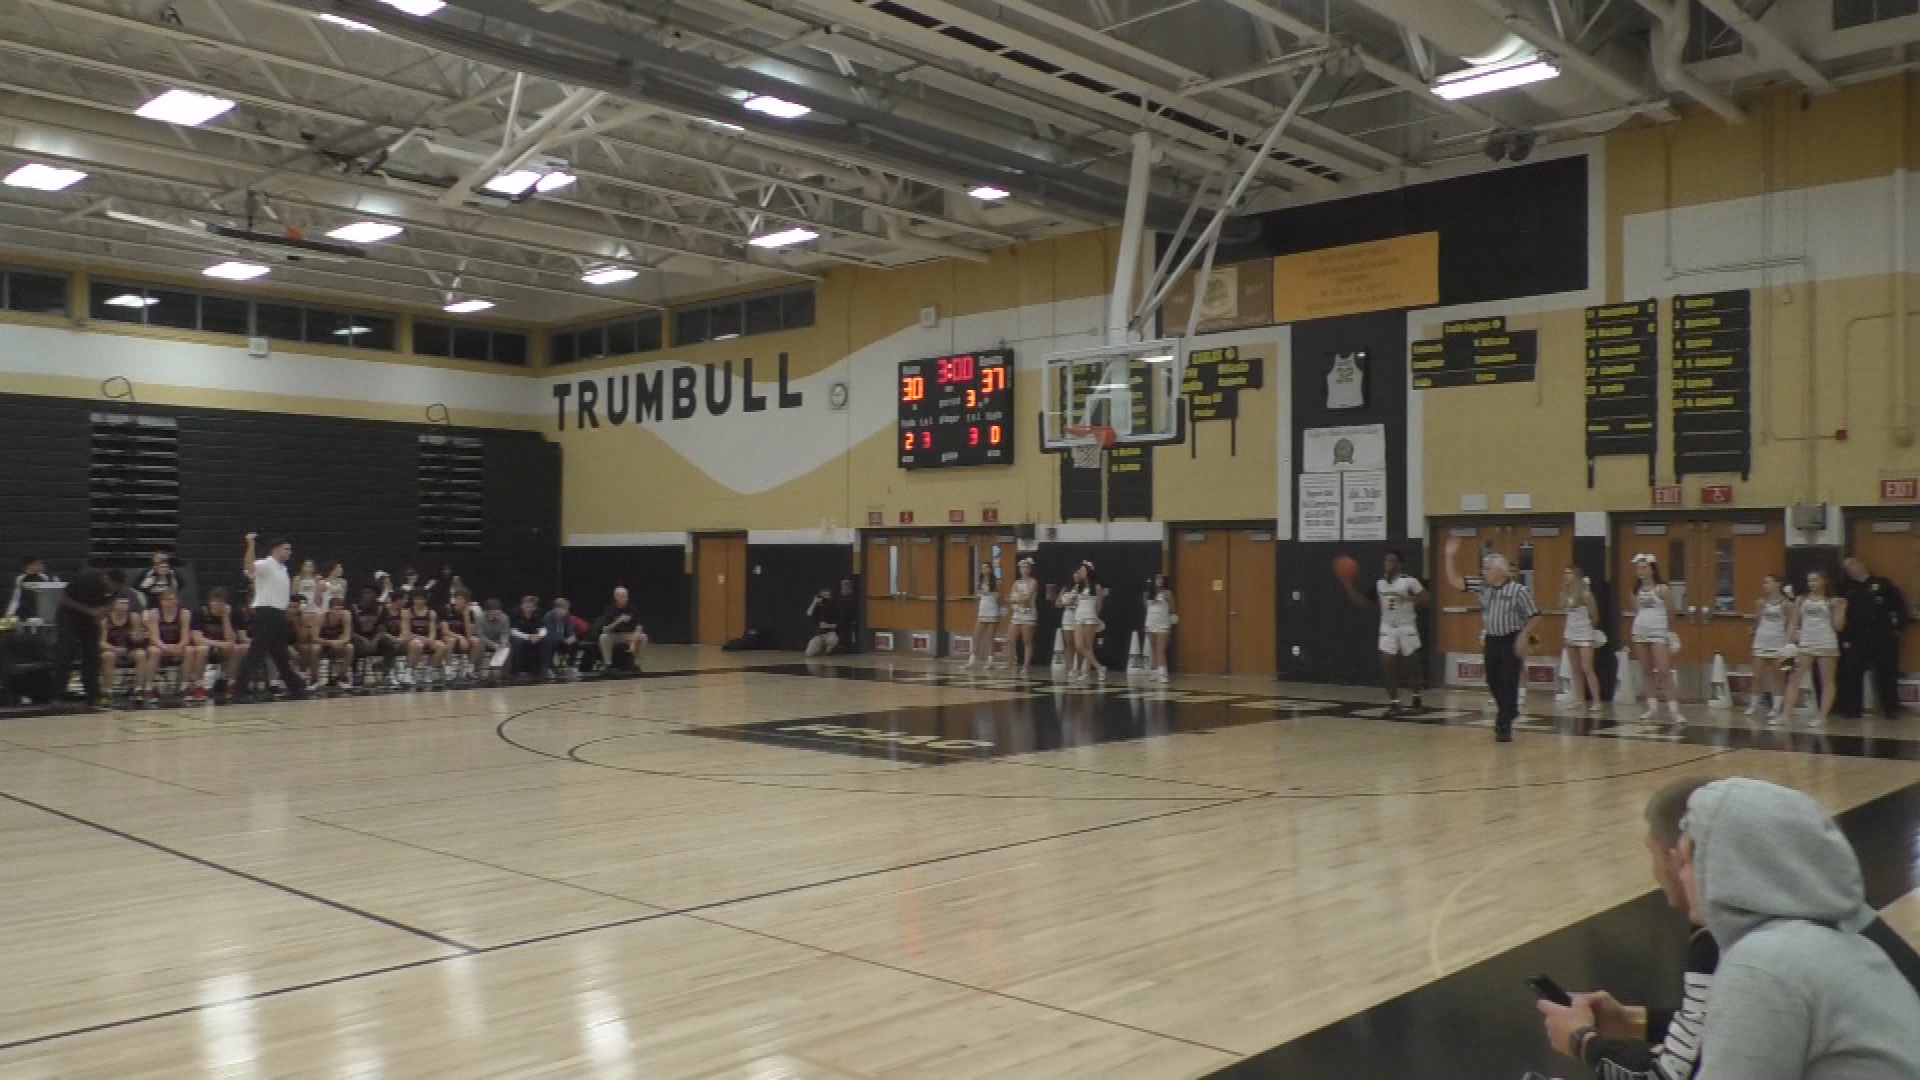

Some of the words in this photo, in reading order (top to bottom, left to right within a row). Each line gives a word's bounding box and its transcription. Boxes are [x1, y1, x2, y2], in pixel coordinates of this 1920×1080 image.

[938, 358, 974, 382] 3:00
[902, 377, 924, 401] 30
[982, 368, 1004, 392] 37
[553, 352, 803, 430] TRUMBULL
[966, 390, 976, 406] 3
[904, 432, 915, 451] 2
[921, 431, 931, 449] 3
[968, 427, 979, 445] 3
[990, 425, 1001, 445] 0
[1886, 481, 1914, 497] EXIT
